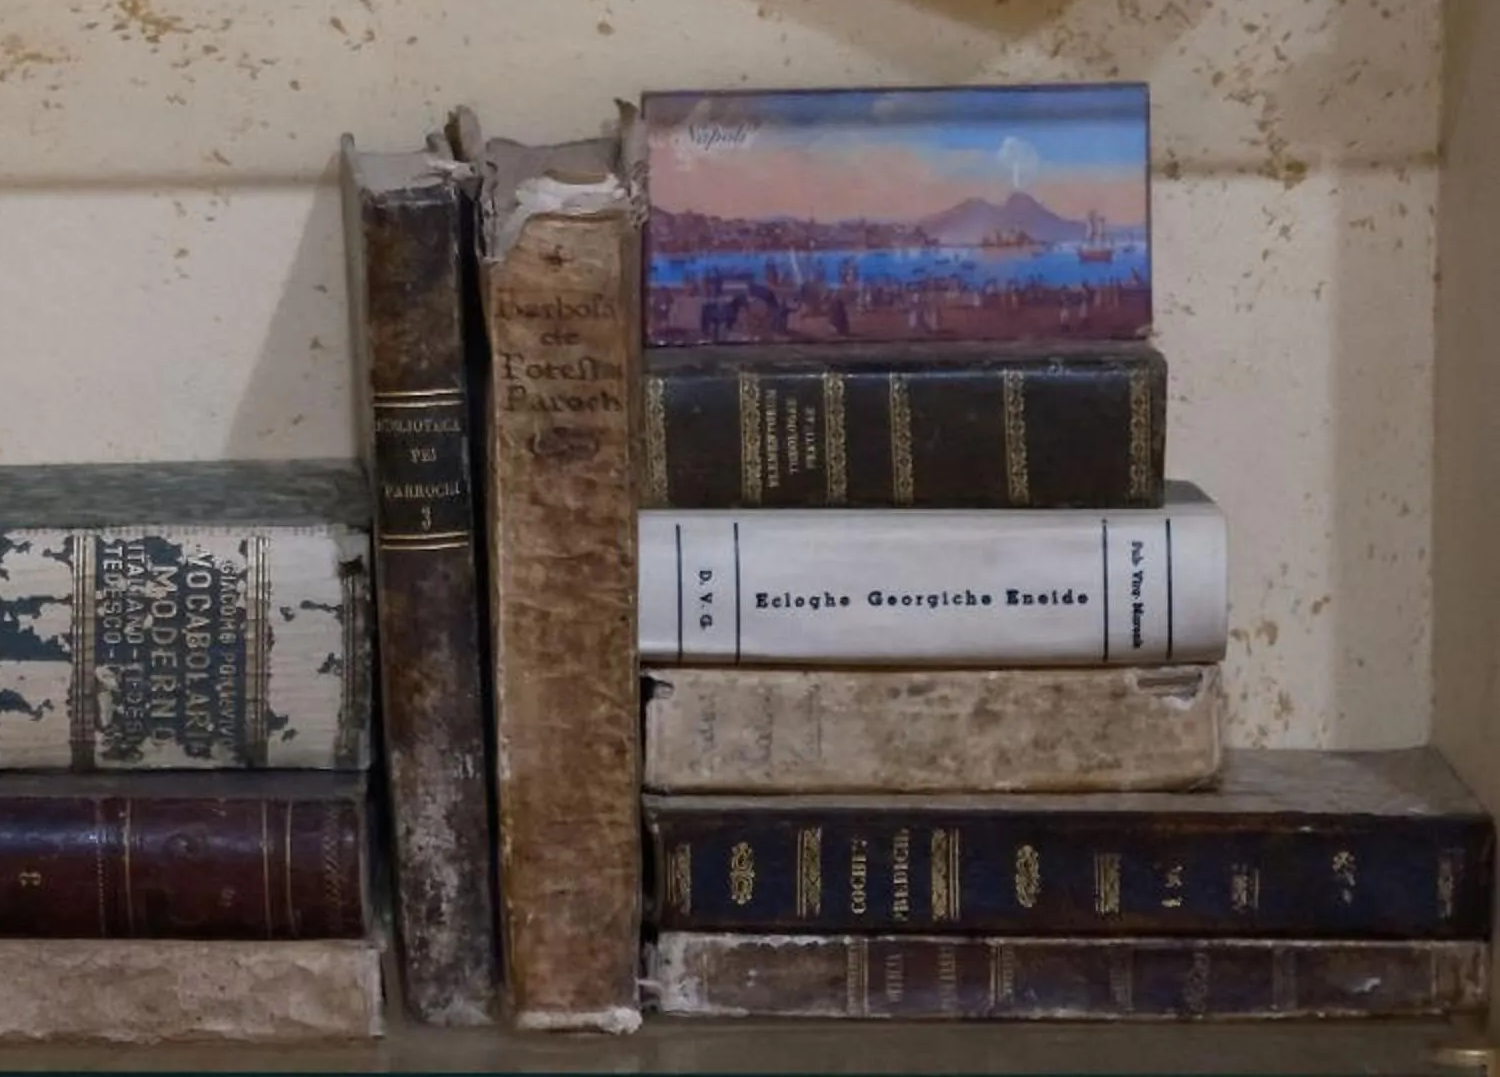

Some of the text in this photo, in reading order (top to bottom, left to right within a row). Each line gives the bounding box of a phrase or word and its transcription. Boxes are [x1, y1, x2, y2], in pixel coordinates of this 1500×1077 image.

[420, 506, 434, 532] 3
[755, 589, 1090, 610] Ecloghe Georgiche Eneide
[149, 565, 178, 747] MODERNO
[17, 871, 43, 888] 3
